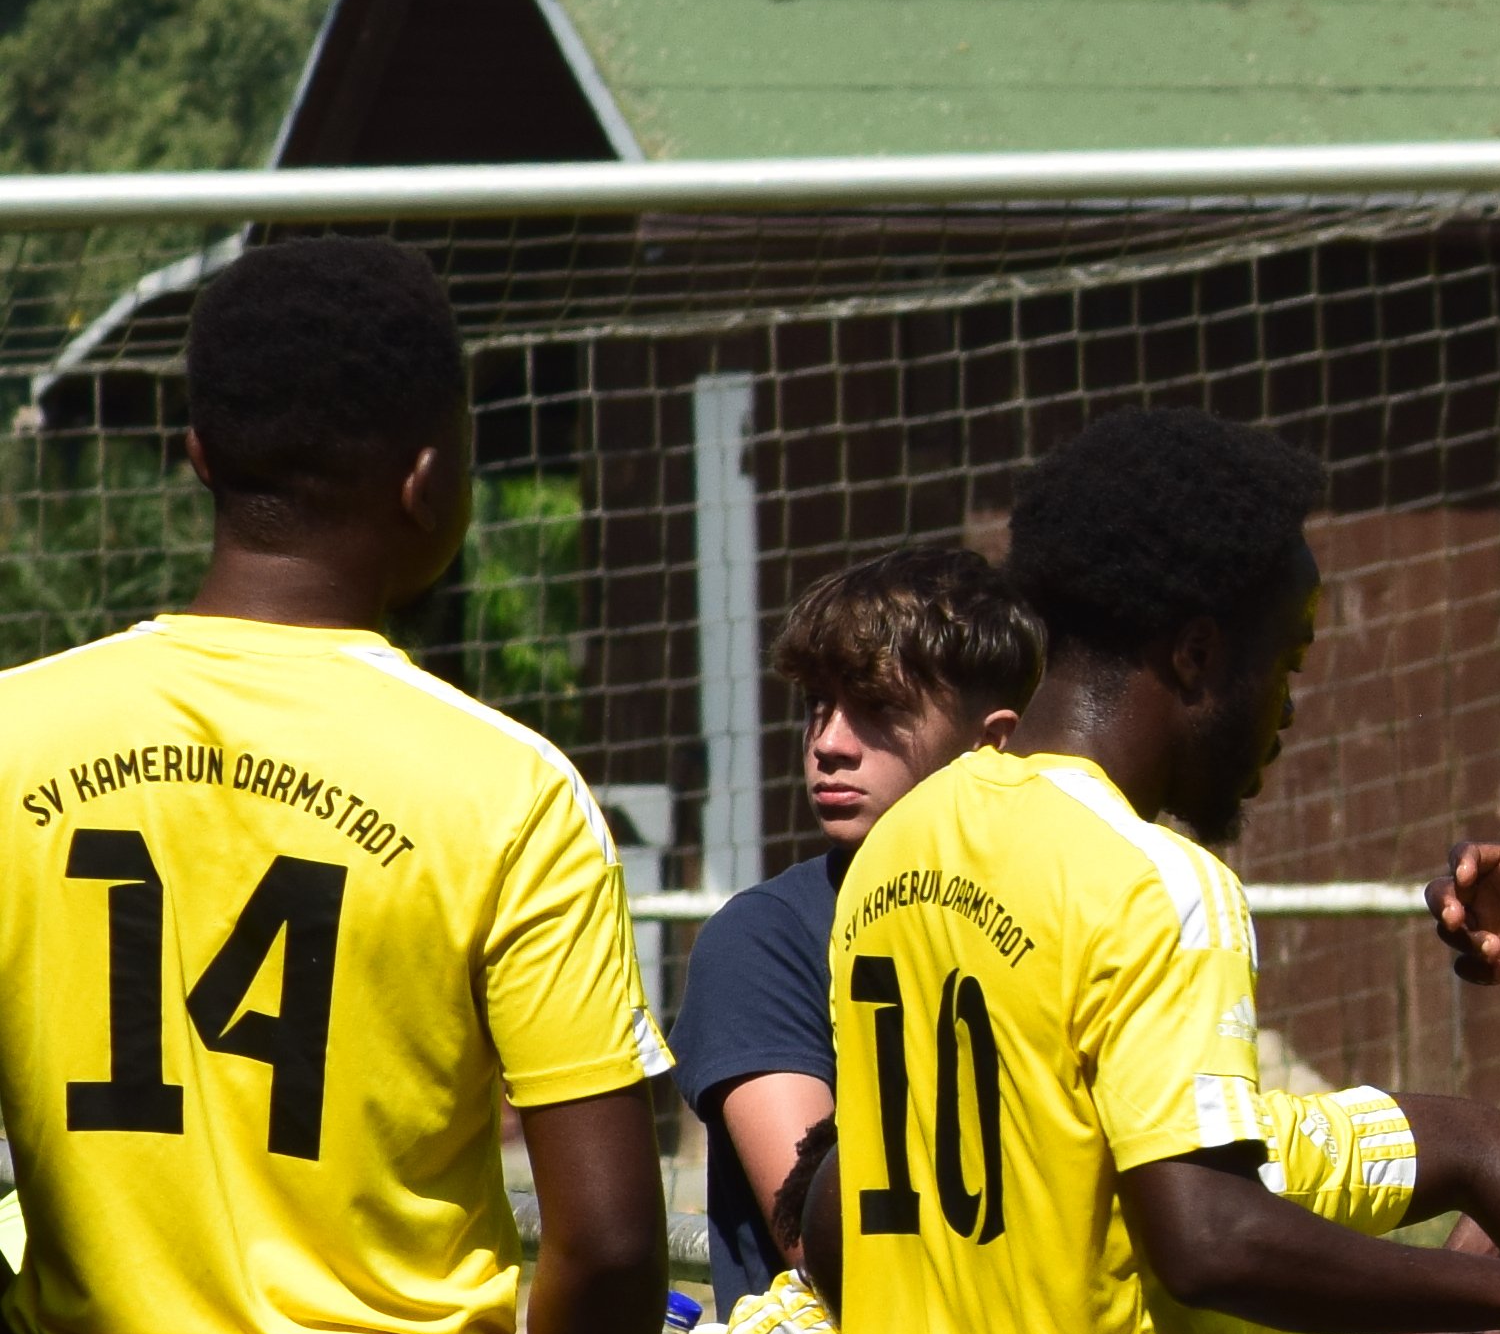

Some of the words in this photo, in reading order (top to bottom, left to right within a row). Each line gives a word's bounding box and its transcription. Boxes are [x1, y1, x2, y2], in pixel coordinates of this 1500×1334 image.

[23, 778, 65, 827] SV
[70, 745, 224, 802] KAMERUN
[234, 753, 415, 868] DARMSTADT
[66, 829, 348, 1161] 14
[845, 907, 859, 952] SV
[863, 870, 942, 927] KAMERUN
[941, 876, 1035, 968] DARMSTADT
[851, 955, 1005, 1246] 10
